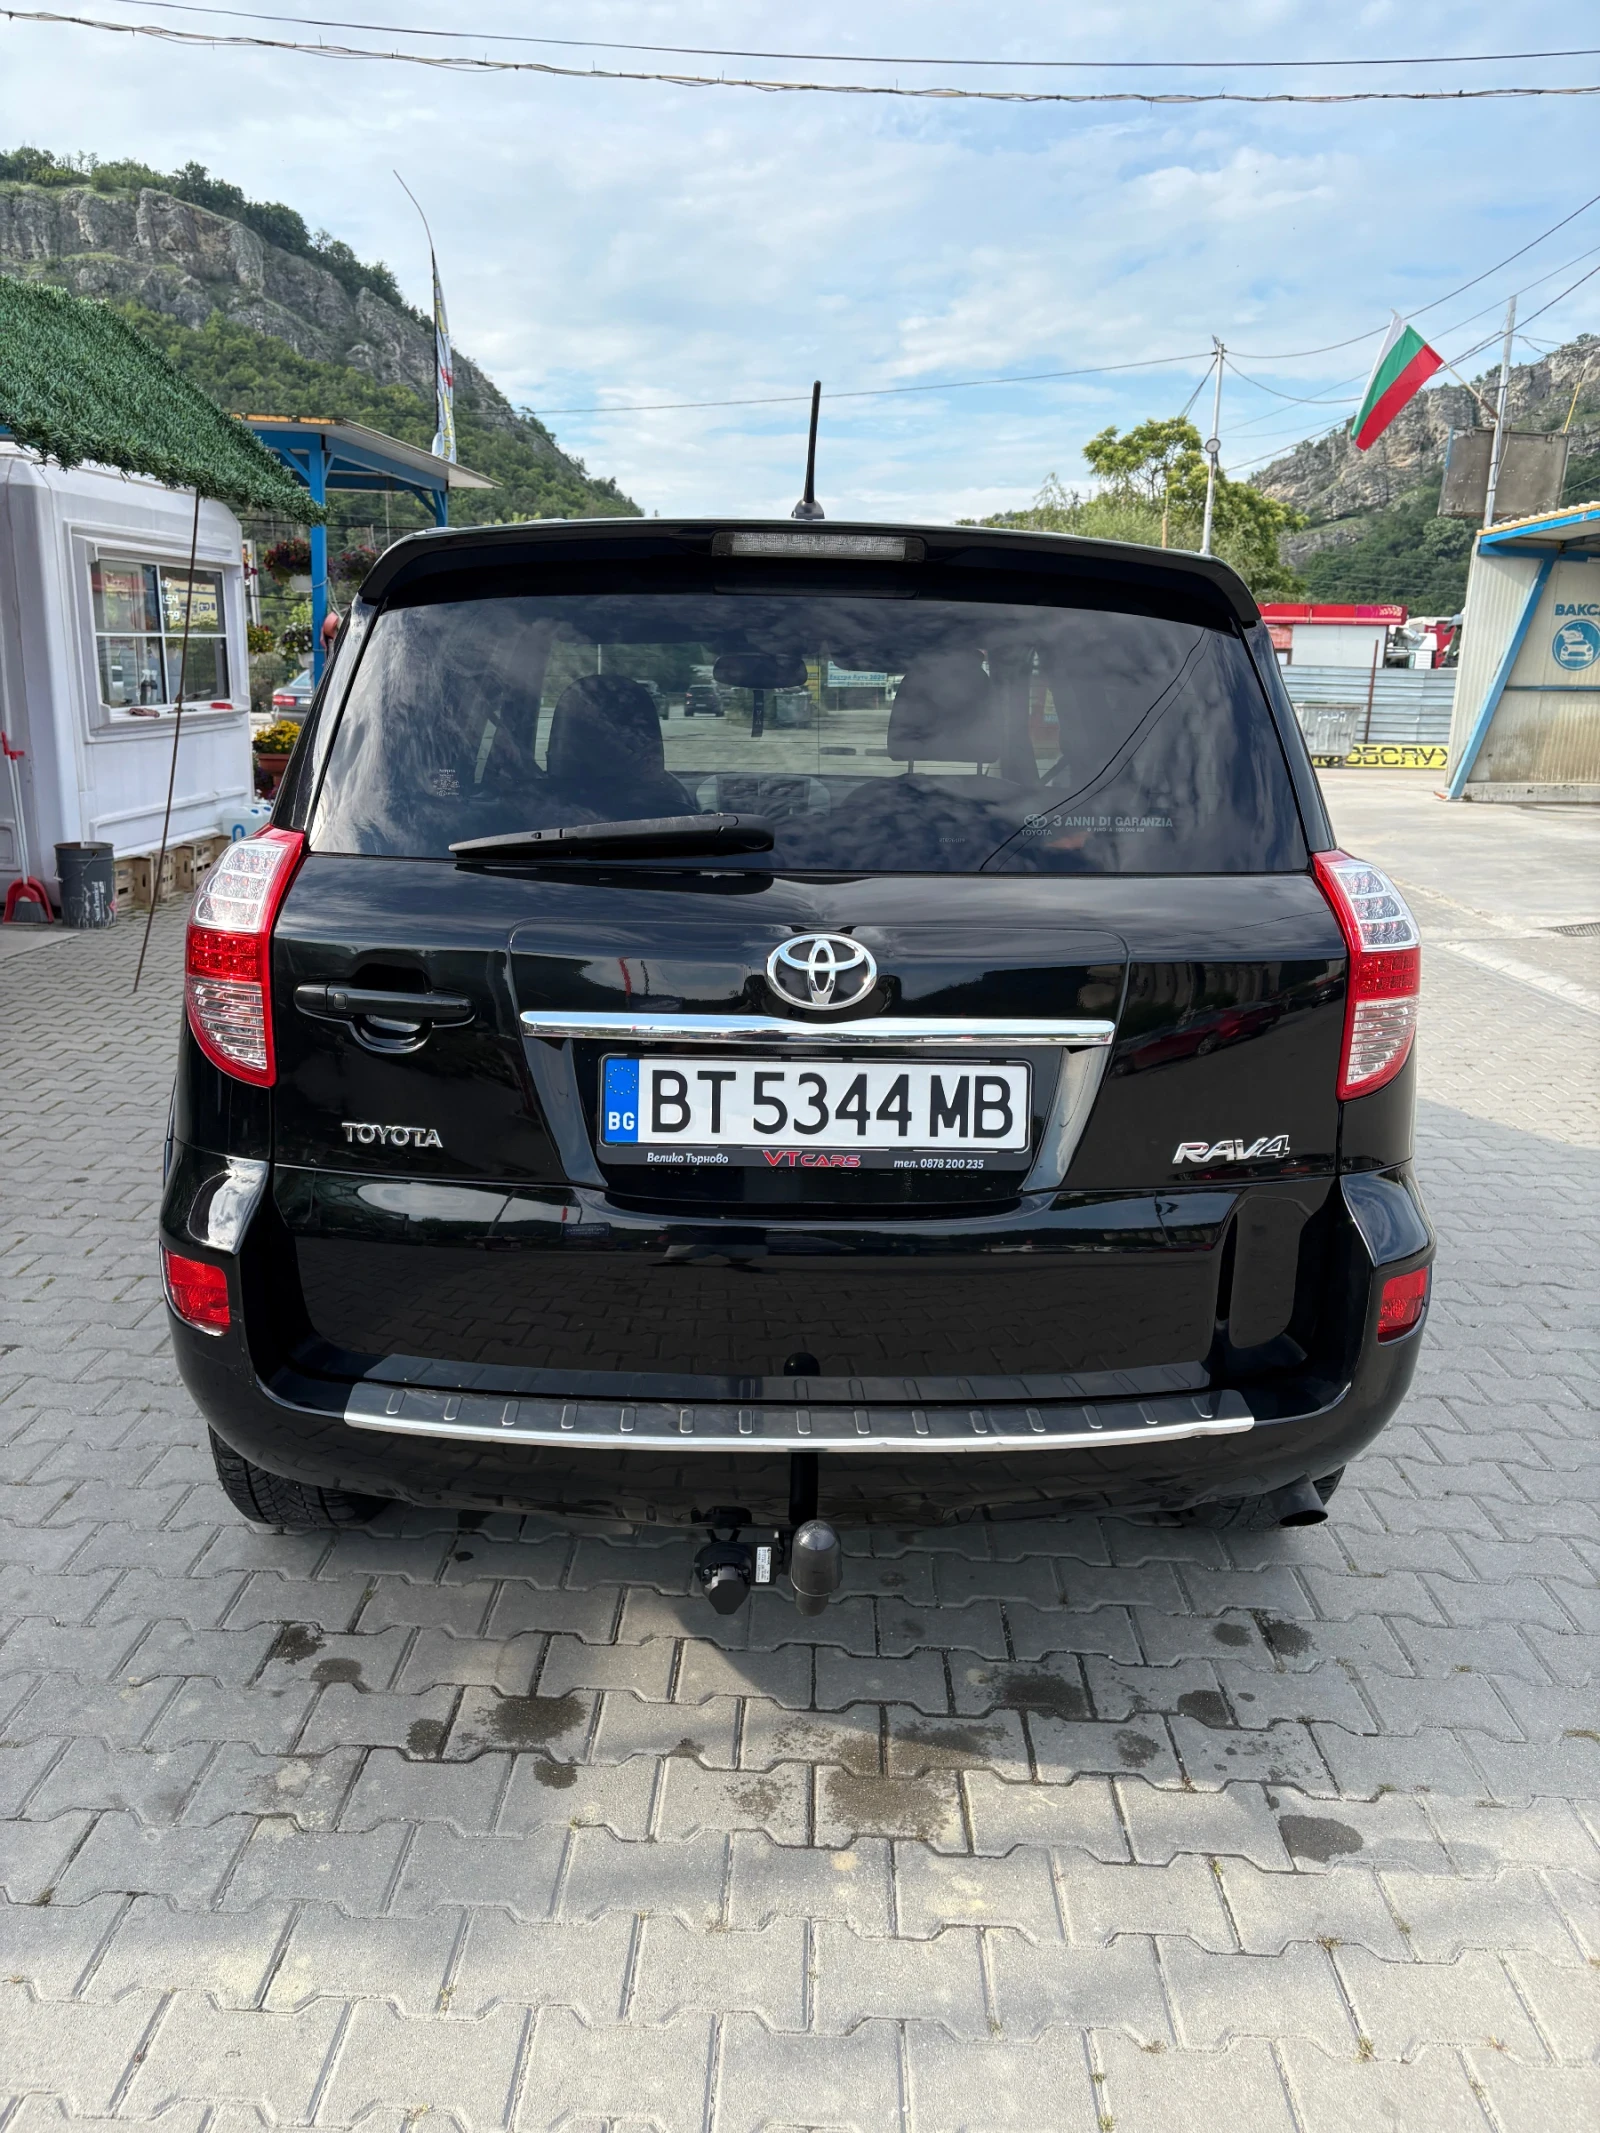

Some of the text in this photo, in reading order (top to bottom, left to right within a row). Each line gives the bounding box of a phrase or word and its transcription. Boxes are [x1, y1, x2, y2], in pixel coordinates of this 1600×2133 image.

[1555, 603, 1600, 616] ВАКС
[1053, 814, 1173, 828] 3 ANNI DI GARANZIA
[651, 1069, 1013, 1138] BT 5344 MB
[608, 1111, 635, 1131] BG
[341, 1122, 444, 1148] TOYOTA
[1172, 1134, 1291, 1164] RAV4
[647, 1152, 729, 1165] Велико Търново
[894, 1158, 984, 1169] тел. 0878 200 235
